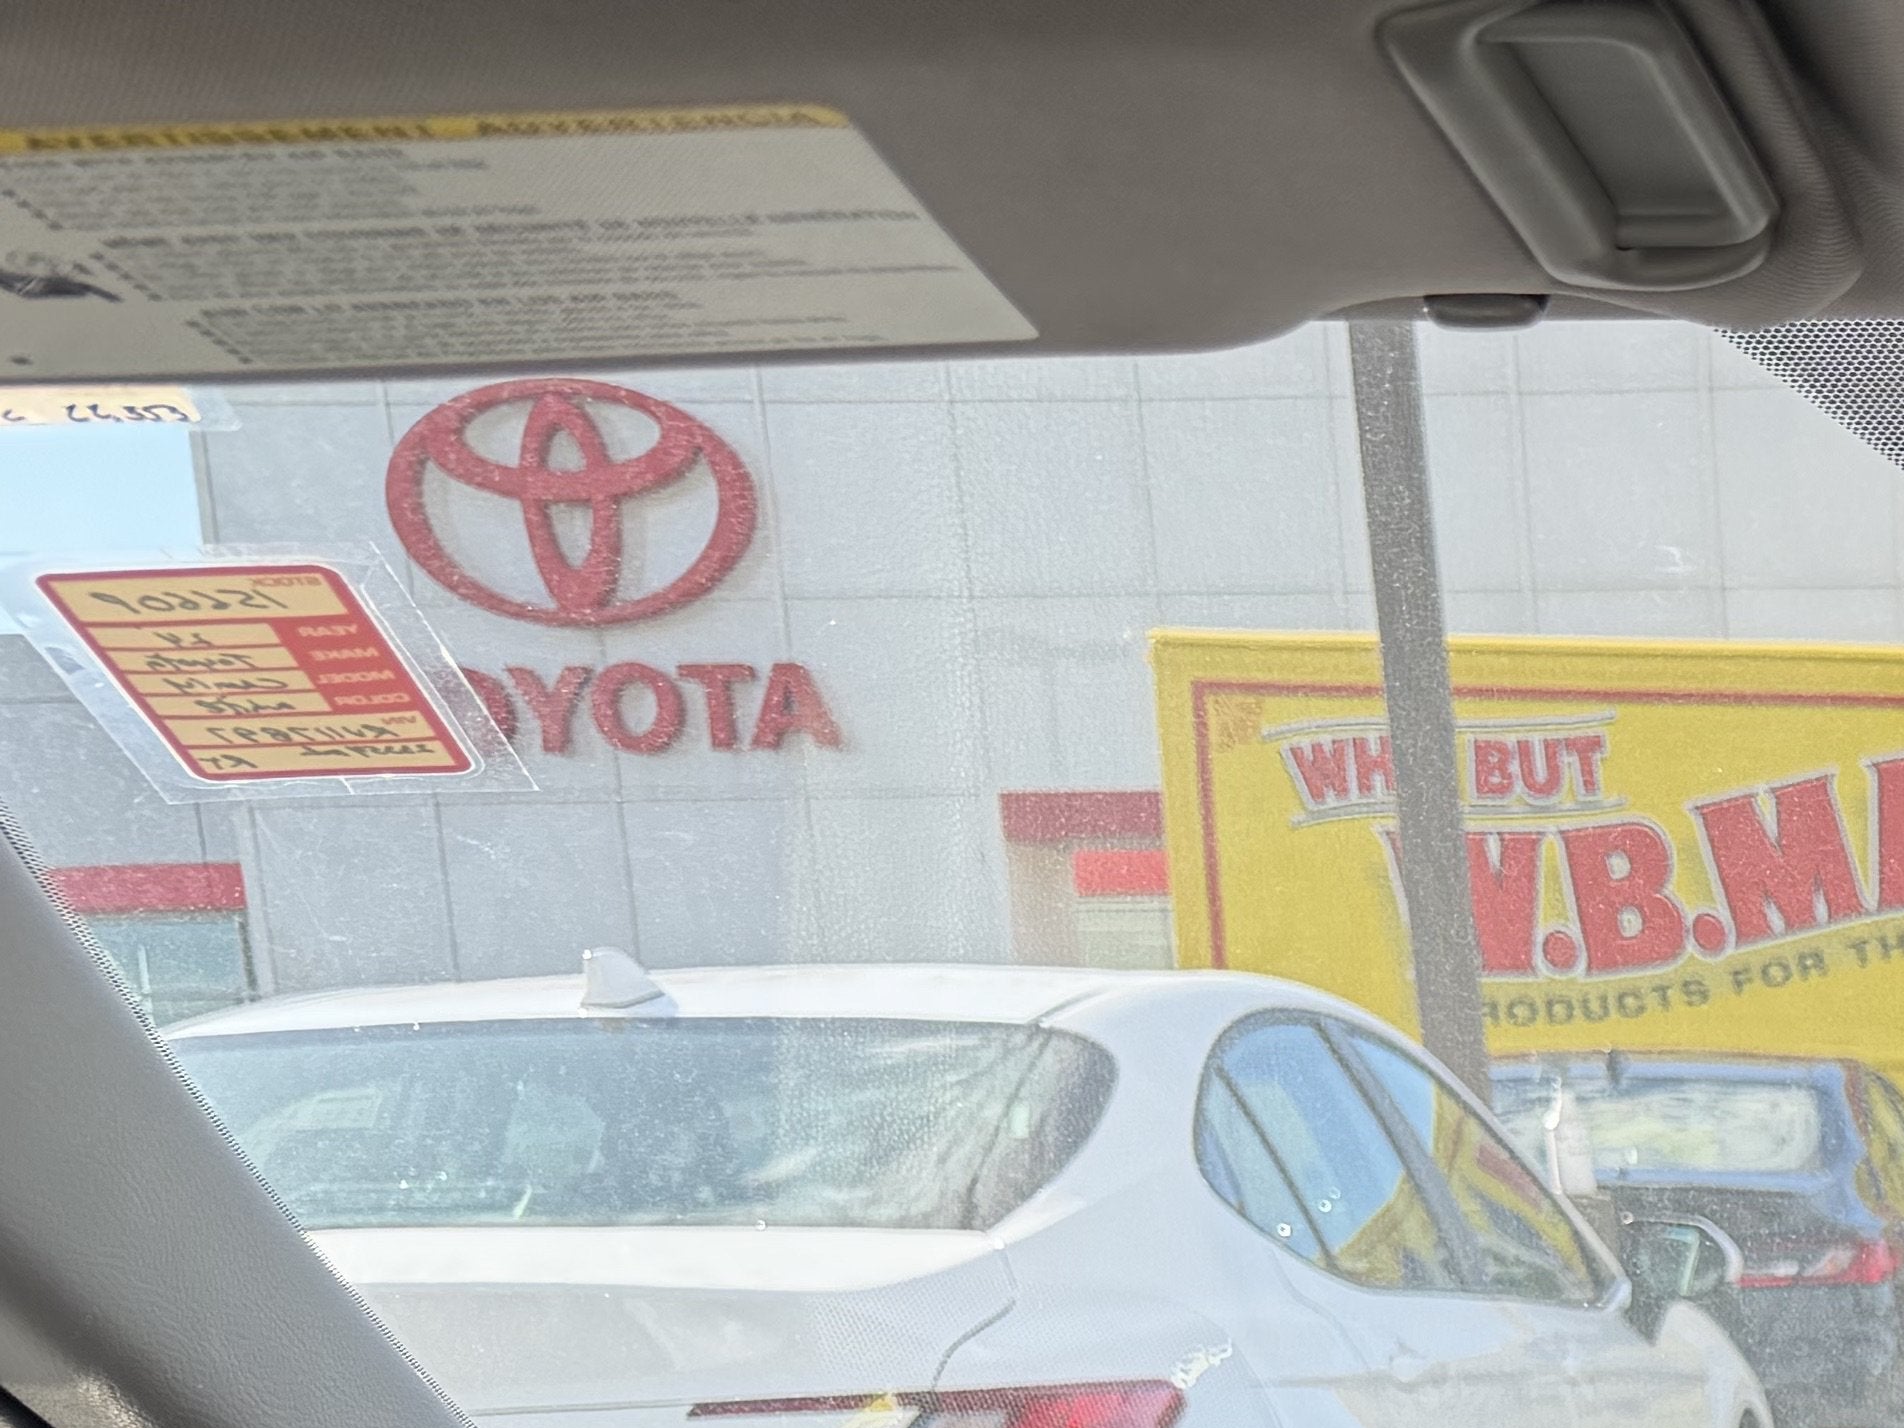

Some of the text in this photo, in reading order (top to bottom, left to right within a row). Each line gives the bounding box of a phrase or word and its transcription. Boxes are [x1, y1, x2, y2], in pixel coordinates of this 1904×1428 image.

[425, 663, 843, 755] OYOTA
[1289, 735, 1606, 805] WH BUT
[1480, 978, 1712, 1029] RODUCTS
[1732, 953, 1829, 997] FOR
